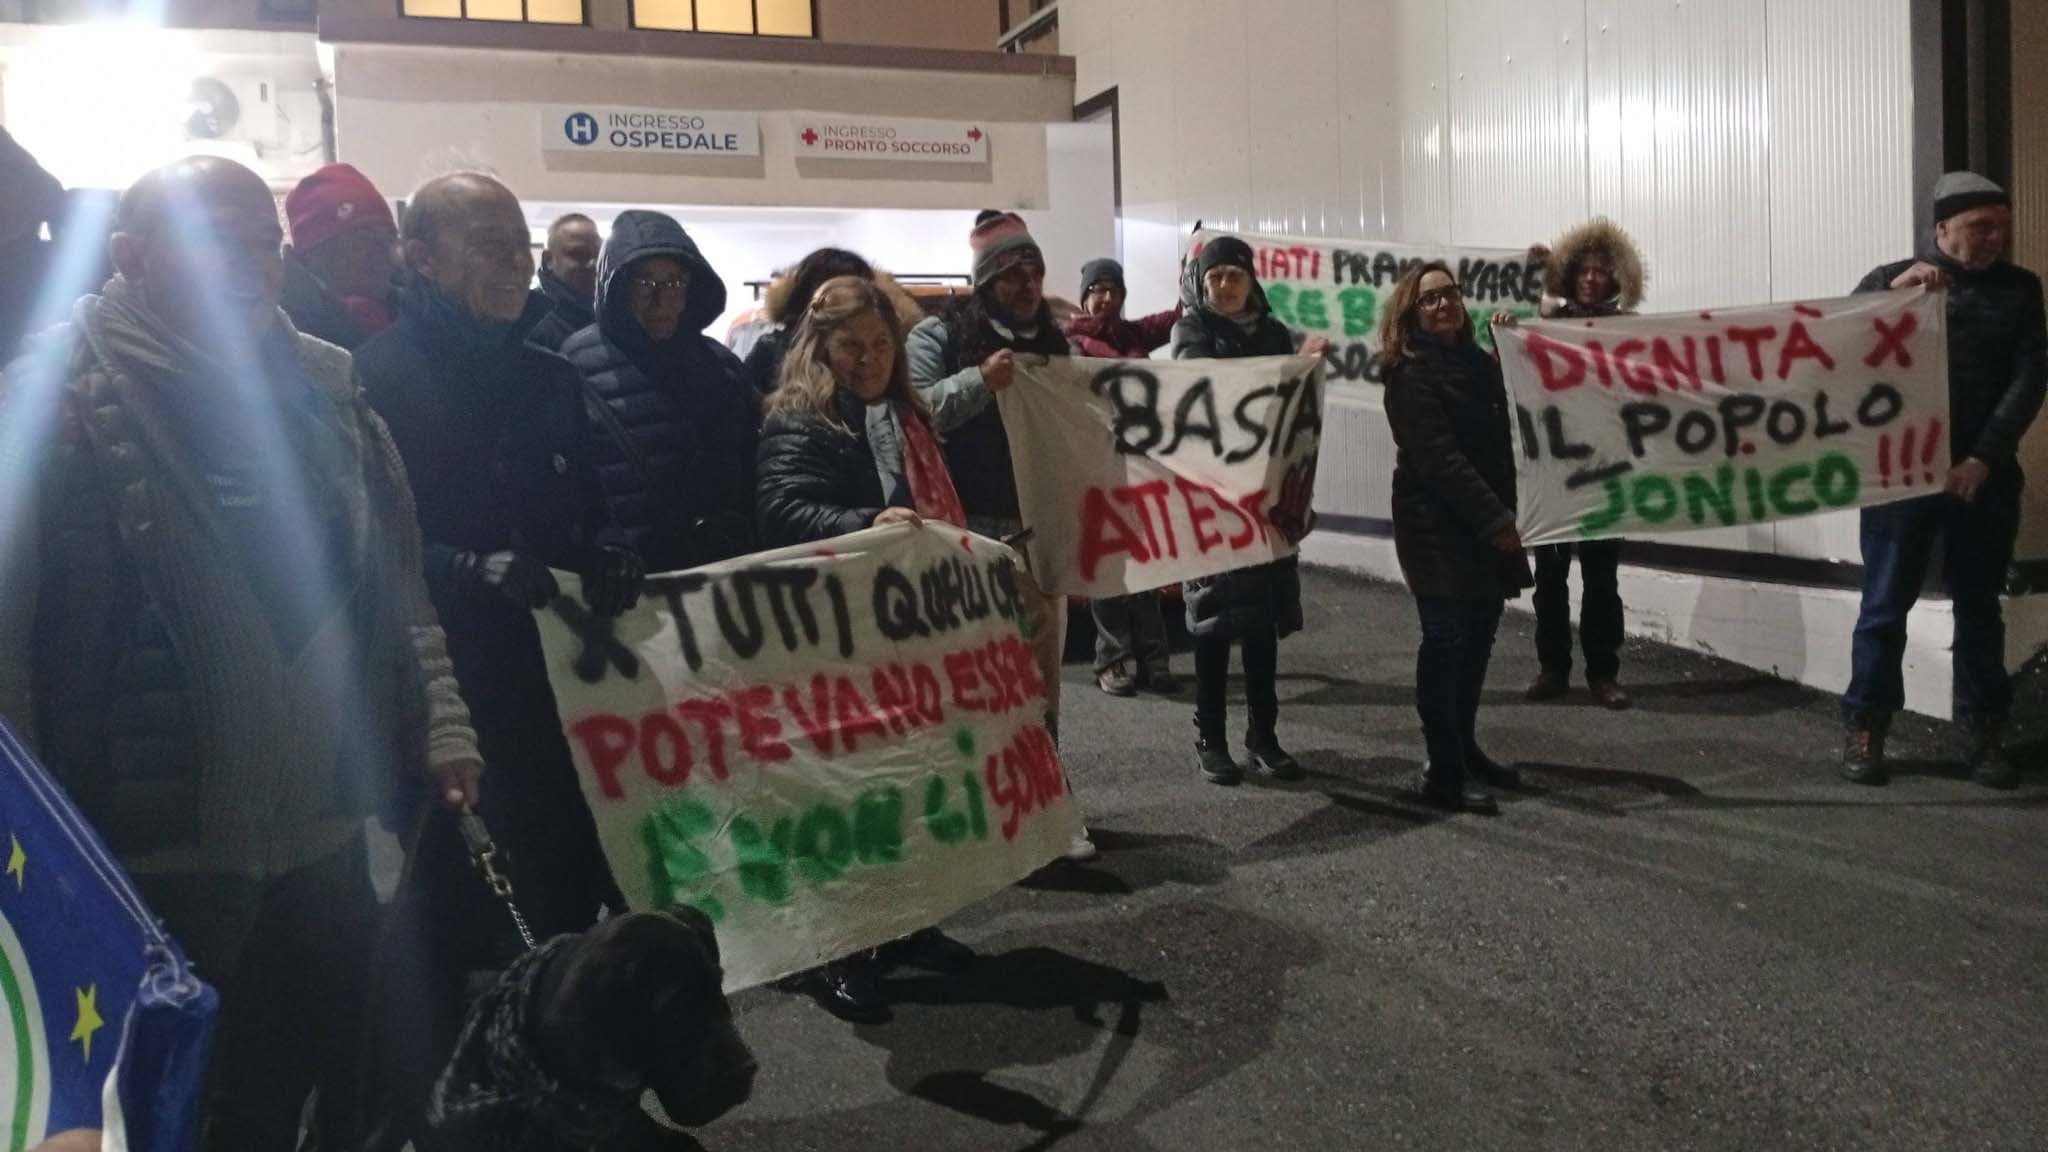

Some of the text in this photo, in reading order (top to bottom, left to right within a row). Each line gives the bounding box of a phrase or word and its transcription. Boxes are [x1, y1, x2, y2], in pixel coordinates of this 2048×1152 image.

[608, 113, 705, 130] INGRESSO
[609, 130, 738, 151] OSPEDALE
[823, 125, 897, 139] INGRESSO
[824, 139, 972, 155] PRONTO SOCCORSO
[1864, 311, 1918, 369] X
[1091, 363, 1323, 465] BASTA
[1514, 383, 1903, 460] IL POPOLO
[1875, 416, 1943, 489] !!!
[643, 565, 855, 673] TUTTI
[570, 662, 945, 801] POTEVANO
